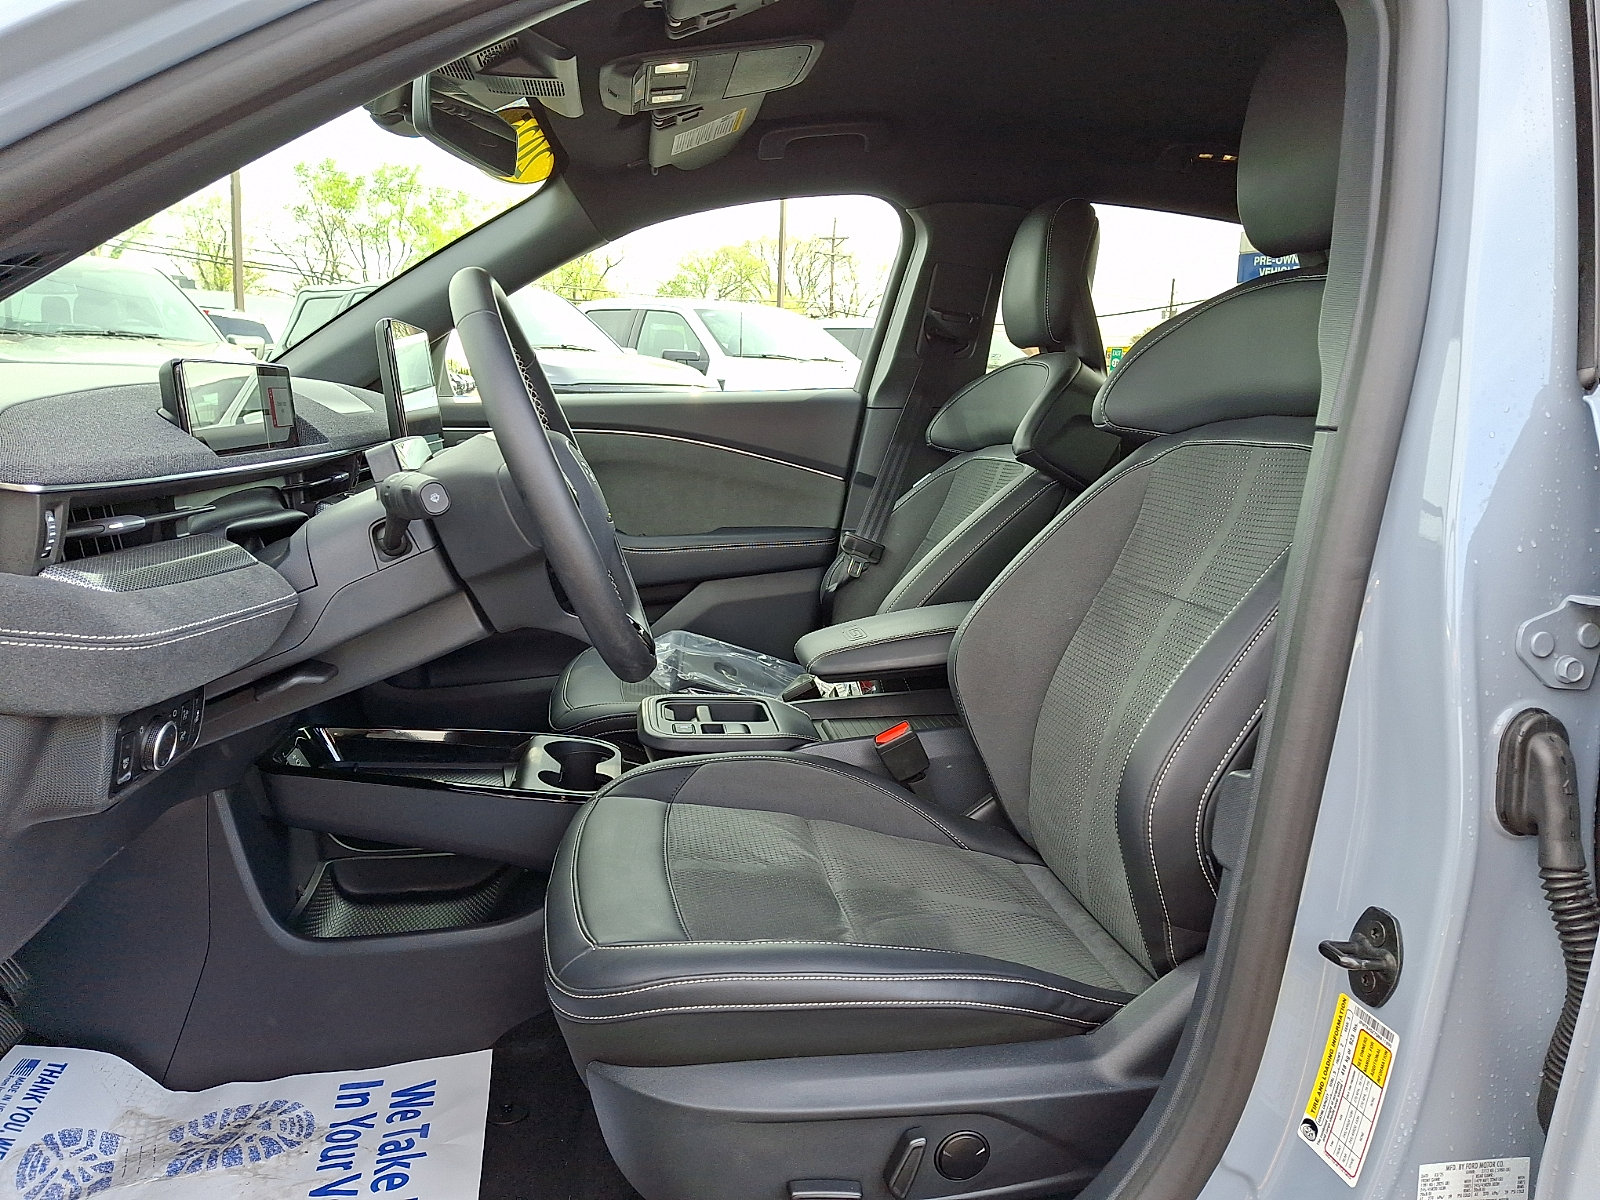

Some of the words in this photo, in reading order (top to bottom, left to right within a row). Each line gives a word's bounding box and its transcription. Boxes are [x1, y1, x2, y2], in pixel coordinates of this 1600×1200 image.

[1311, 1096, 1320, 1115] TIRE
[1317, 1080, 1325, 1096] AND
[1322, 1048, 1334, 1081] LOADING
[1332, 997, 1347, 1048] INFORMATION
[1344, 1054, 1350, 1064] kg
[1359, 1035, 1368, 1058] OWNERS
[1362, 1051, 1371, 1073] MANUAL
[1369, 1047, 1381, 1077] ADDITIONAL
[1376, 1048, 1388, 1084] INFORMATION
[2, 1094, 13, 1102] IN
[8, 1077, 26, 1093] MADE
[22, 1062, 68, 1104] THANK
[334, 1079, 385, 1109] In
[386, 1079, 437, 1124] We
[0, 1106, 38, 1133] YOU,
[316, 1112, 378, 1171] Your
[370, 1123, 430, 1193] Take
[308, 1173, 362, 1200] V
